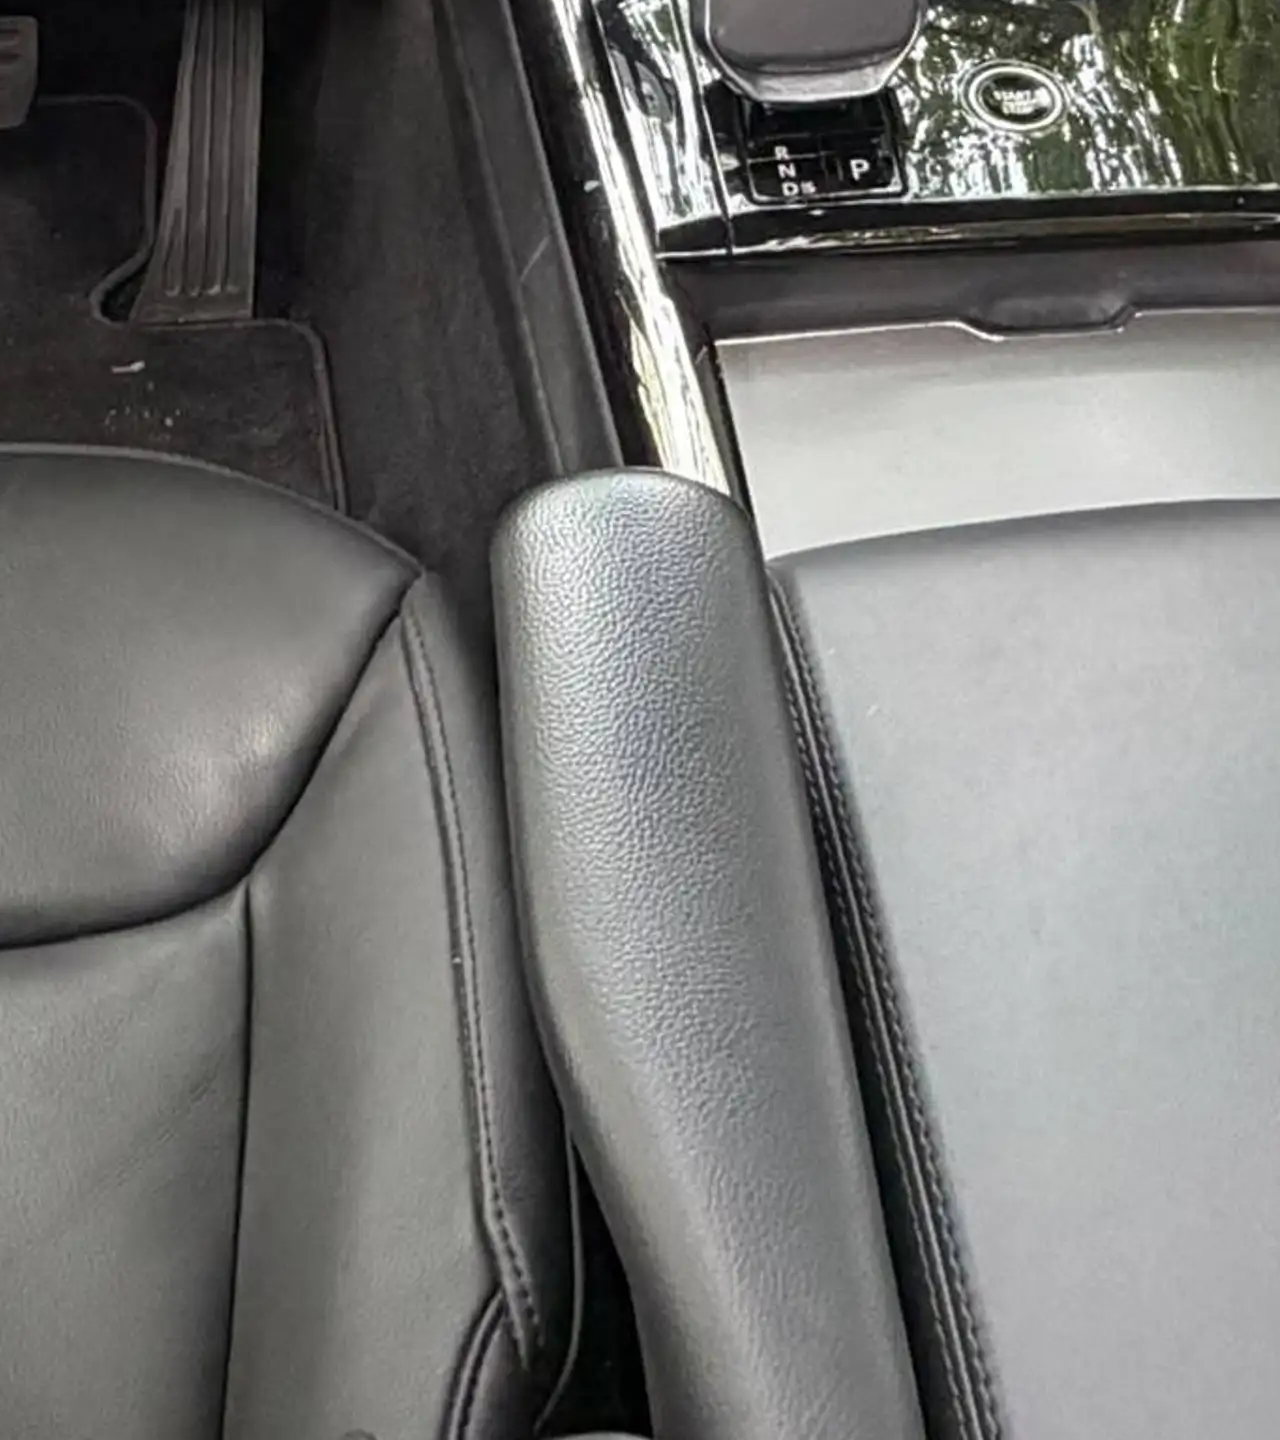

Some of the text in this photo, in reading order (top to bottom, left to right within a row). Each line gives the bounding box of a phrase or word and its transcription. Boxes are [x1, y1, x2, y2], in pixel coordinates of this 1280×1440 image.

[774, 145, 790, 161] R
[777, 162, 797, 179] N
[850, 158, 870, 182] P
[781, 181, 800, 197] D
